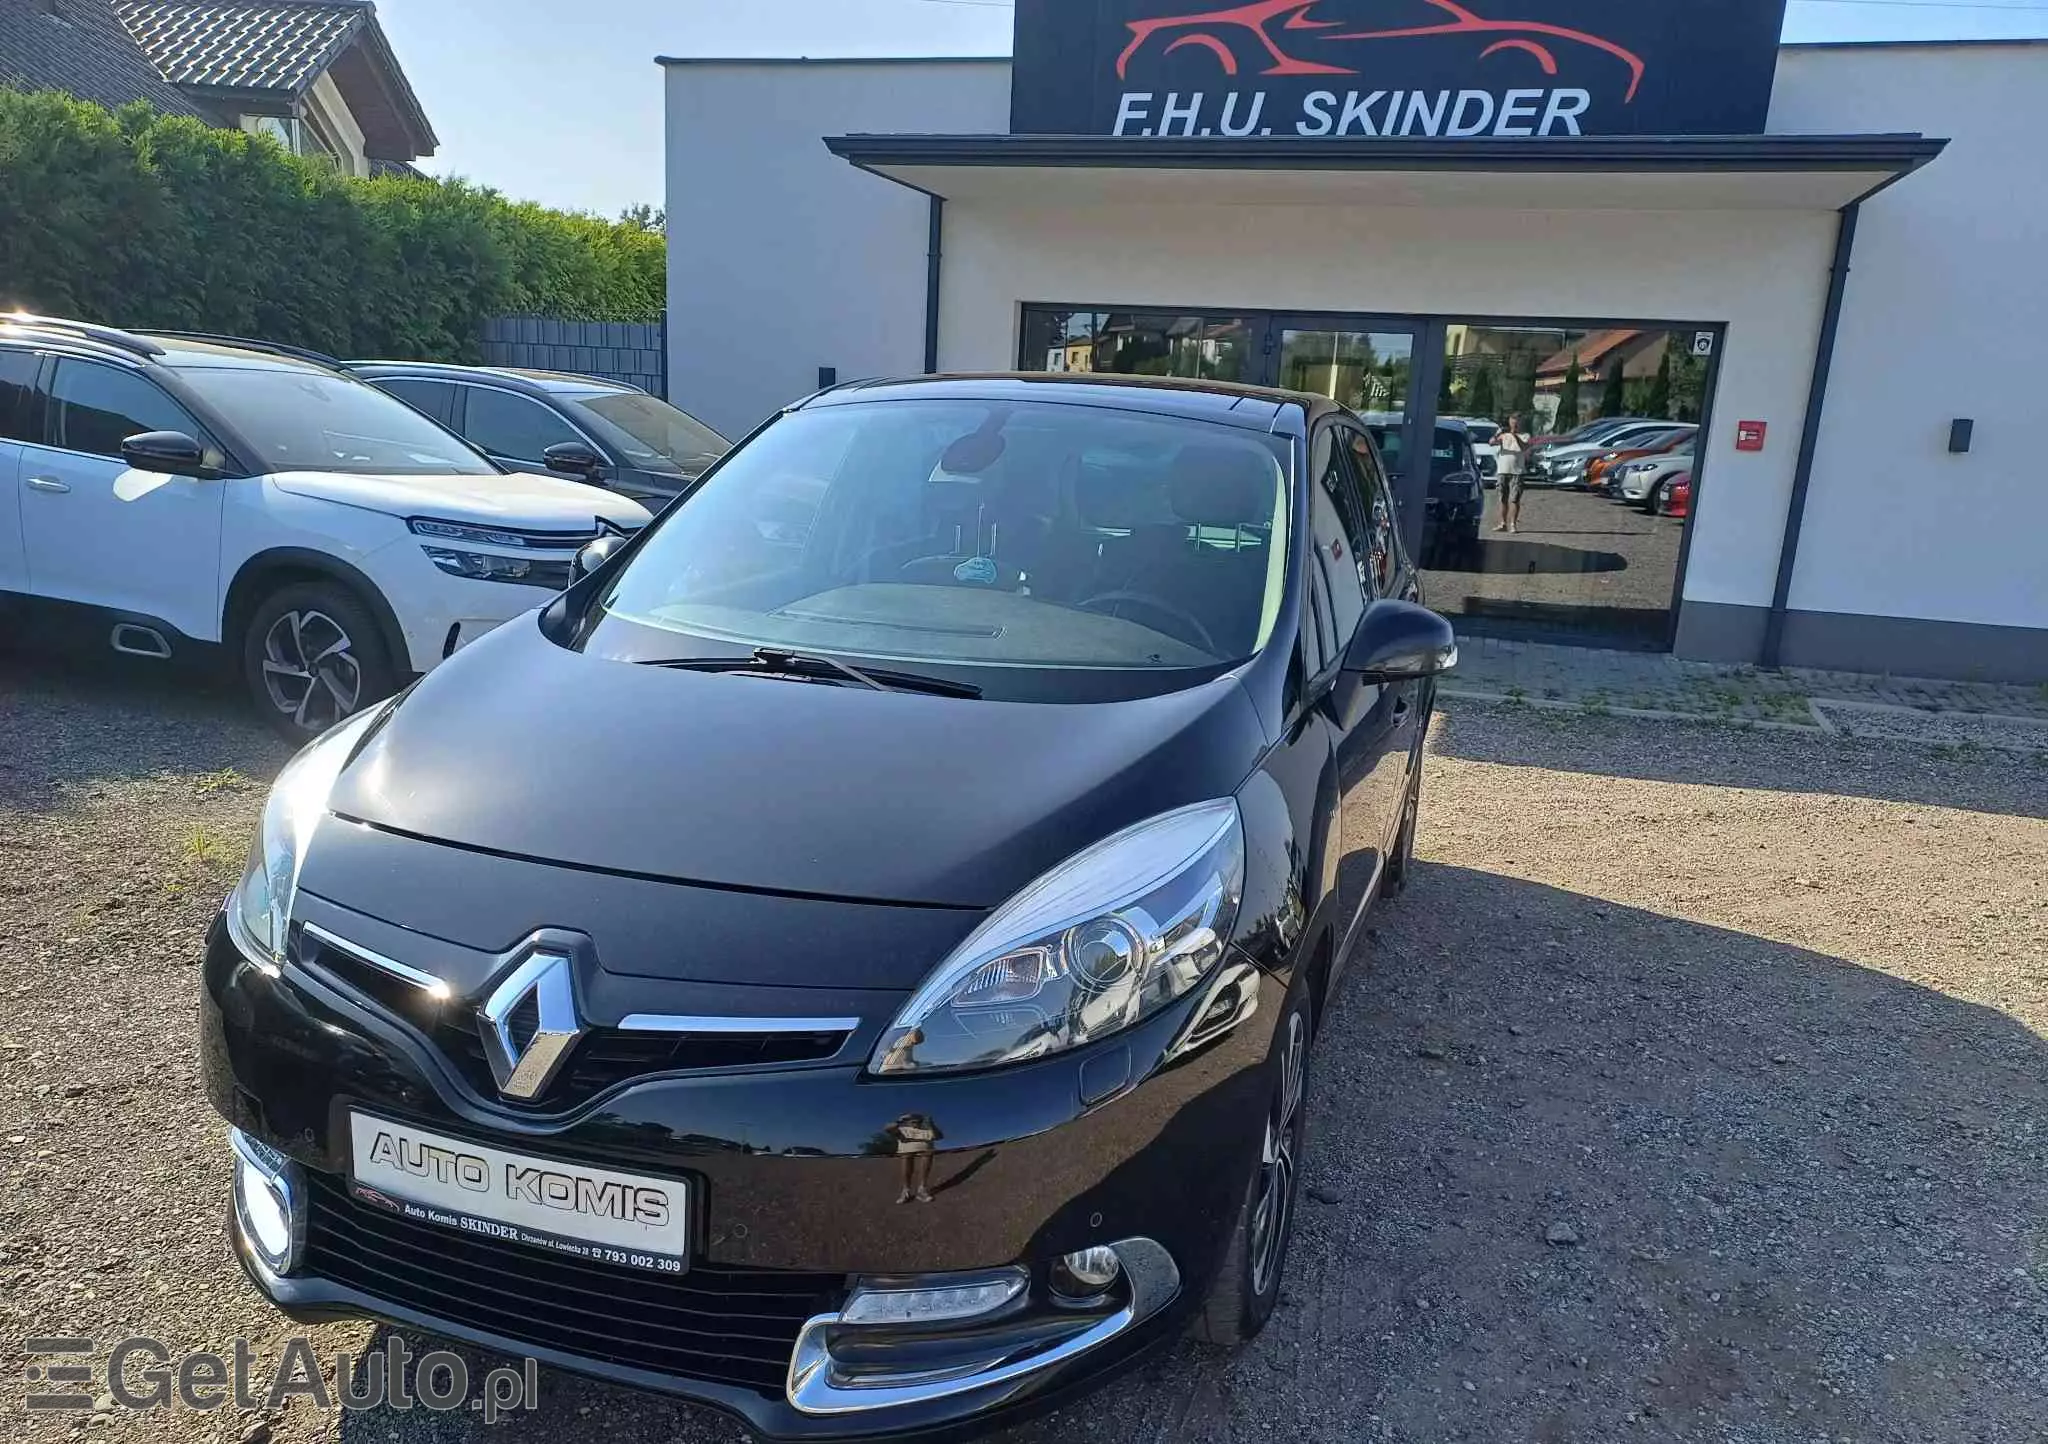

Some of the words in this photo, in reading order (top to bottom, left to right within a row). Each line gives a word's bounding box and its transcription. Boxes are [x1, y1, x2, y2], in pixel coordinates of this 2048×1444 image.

[1112, 92, 1272, 137] F.H.U.
[1296, 88, 1591, 137] SKINDER
[370, 1132, 490, 1193] AUTO
[505, 1164, 670, 1227] KOMIS
[404, 1204, 426, 1219] Auto
[428, 1209, 458, 1226] Komis
[460, 1216, 519, 1241] SKINDER
[604, 1249, 627, 1264] 793
[630, 1254, 654, 1268] 002
[657, 1258, 681, 1272] 309
